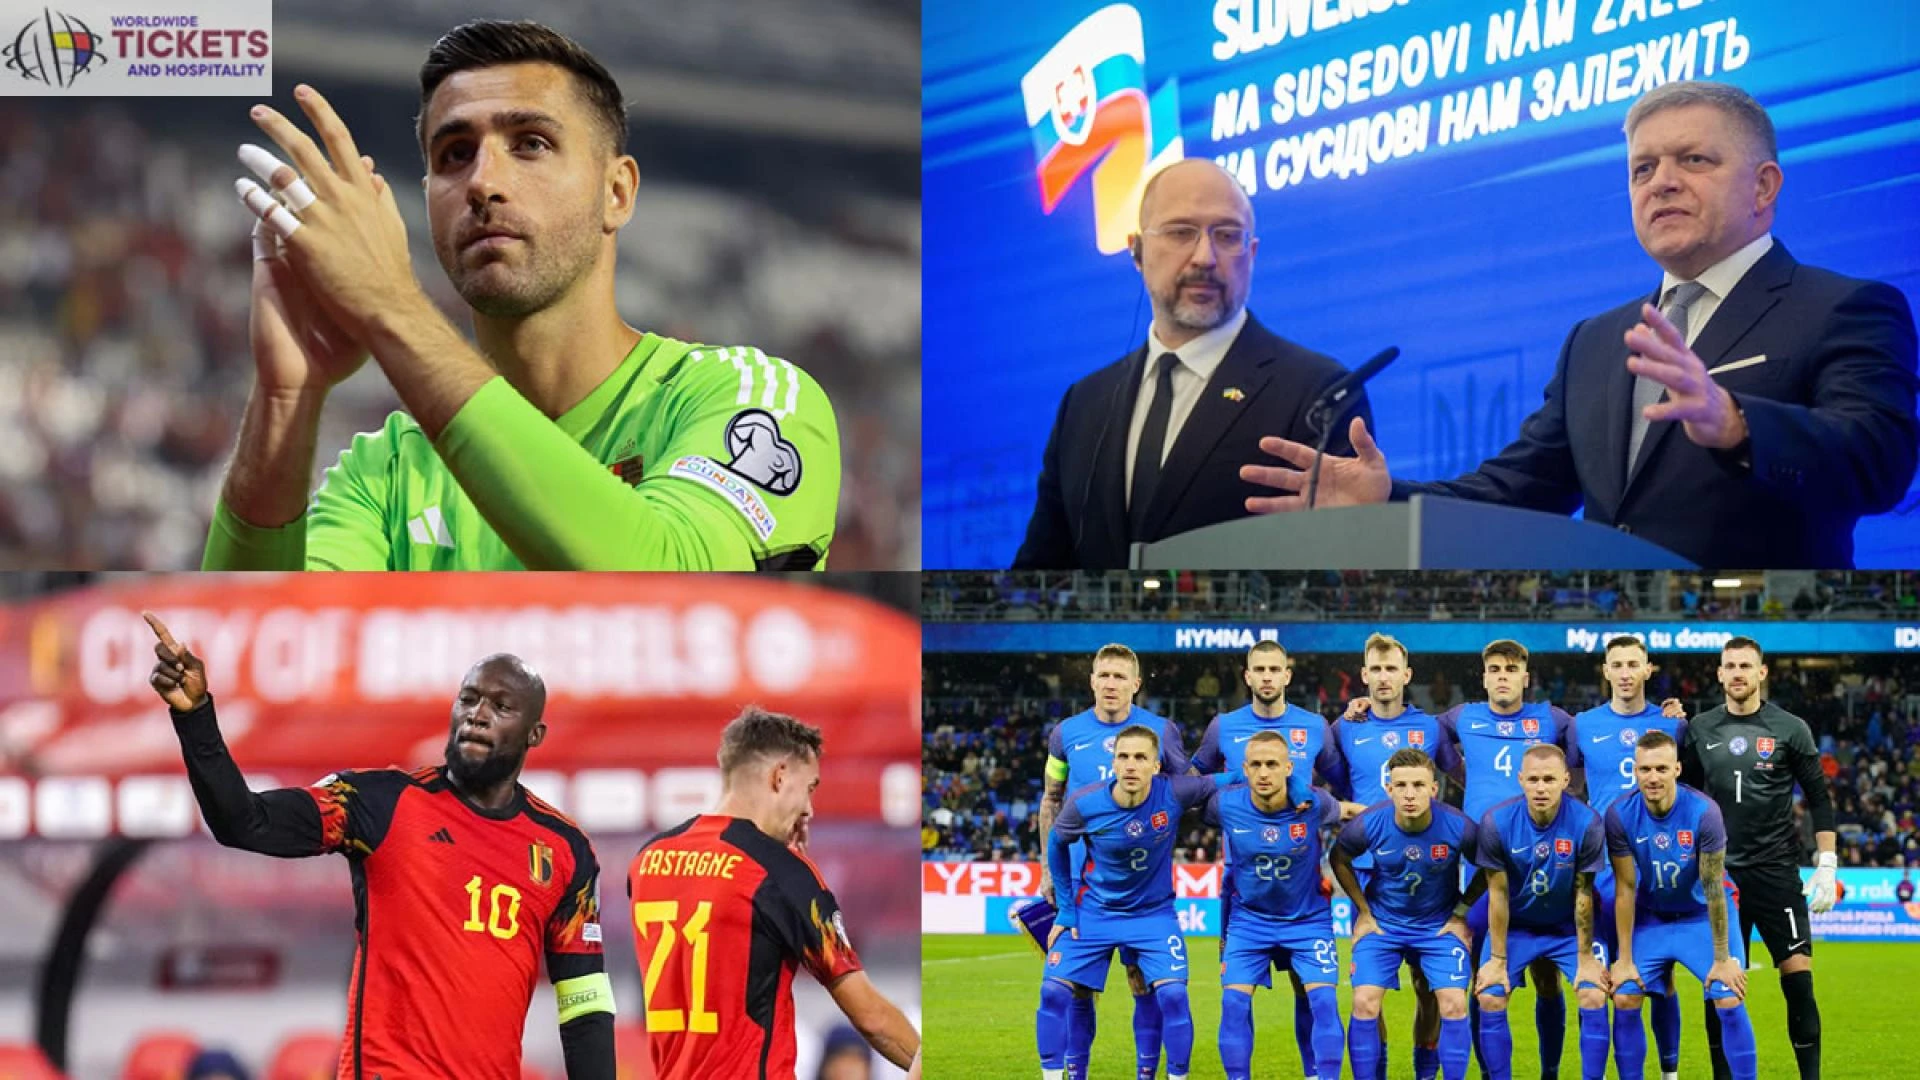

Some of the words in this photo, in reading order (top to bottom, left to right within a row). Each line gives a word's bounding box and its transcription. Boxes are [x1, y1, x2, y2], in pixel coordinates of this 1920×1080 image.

[1211, 83, 1261, 142] NA
[1270, 21, 1472, 125] SUSEDOVI
[1264, 100, 1432, 191] СУСІДОВІ
[1437, 76, 1523, 147] НАМ
[1528, 16, 1751, 122] ЗАЛЕЖИТЬ
[1175, 627, 1257, 649] HYMNA
[1566, 628, 1599, 653] My
[1650, 630, 1673, 649] tu
[1493, 745, 1513, 777] 4
[1619, 757, 1636, 789] 9
[1733, 770, 1743, 804] 1
[639, 849, 744, 880] CASTAGNE
[1129, 847, 1149, 872] 2
[1254, 855, 1293, 881] 22
[1652, 860, 1681, 889] 17
[1404, 871, 1422, 897] 7
[1531, 869, 1550, 896] 8
[463, 874, 522, 940] 10
[1783, 906, 1799, 940] 1
[1167, 935, 1185, 961] 2
[1451, 947, 1466, 973] 7
[633, 900, 720, 1034] 21
